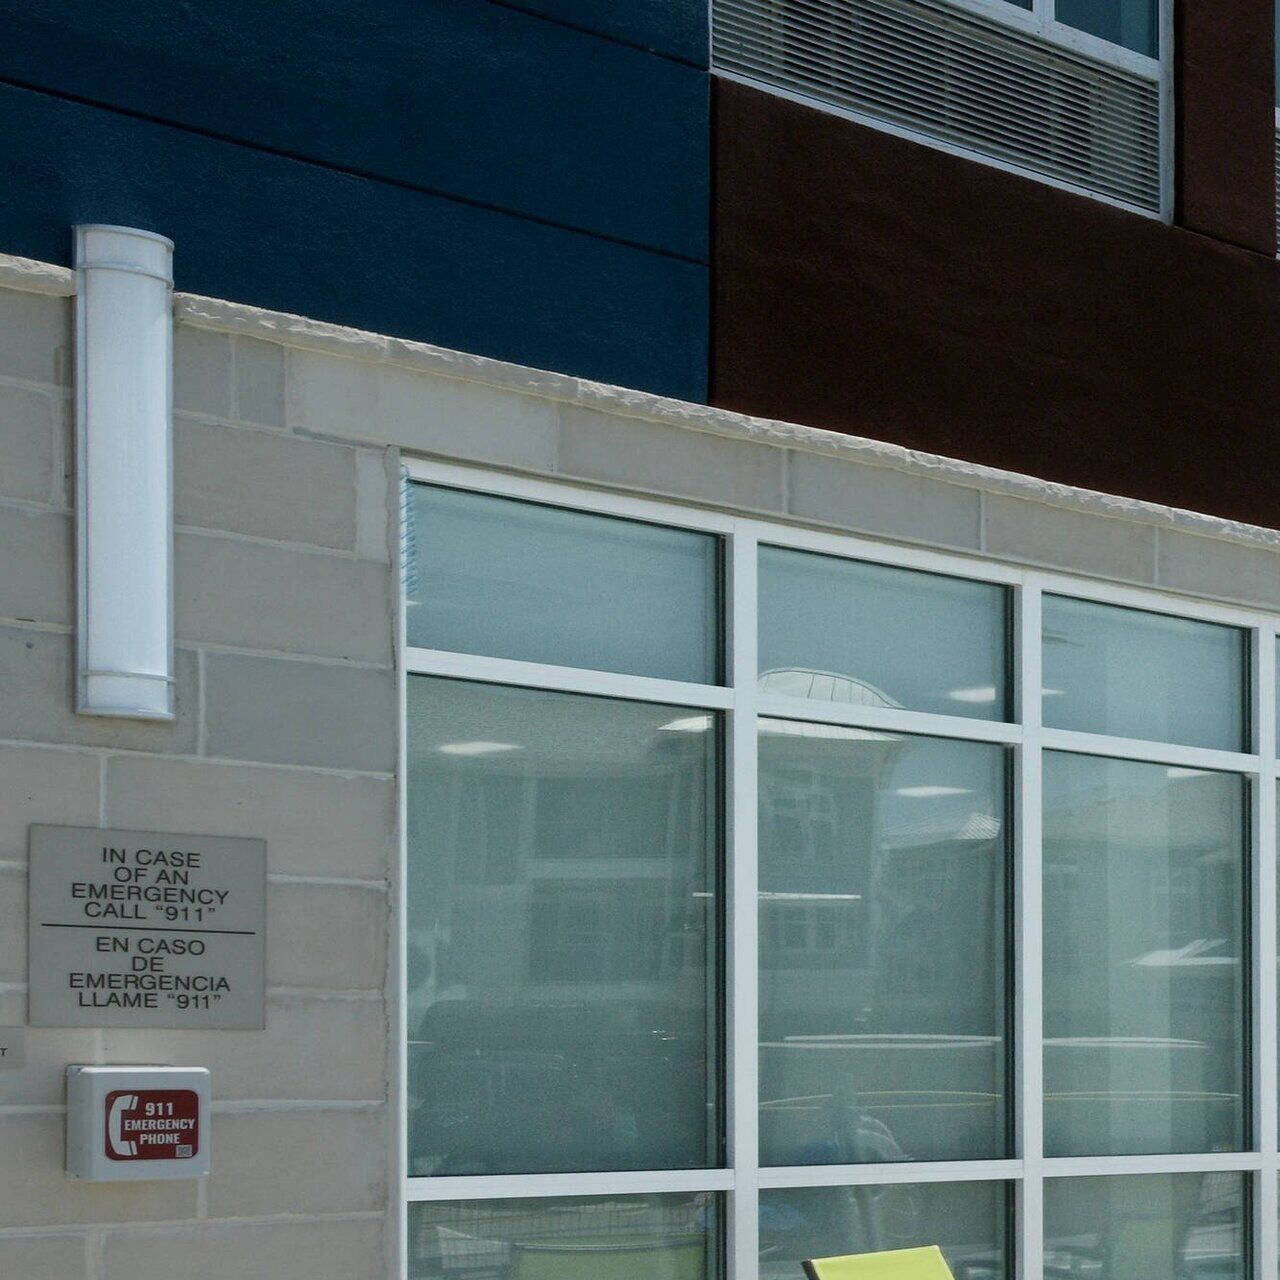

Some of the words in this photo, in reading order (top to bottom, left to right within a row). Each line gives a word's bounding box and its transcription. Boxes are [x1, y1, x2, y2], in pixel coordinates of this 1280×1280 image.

[102, 847, 126, 864] IN
[135, 849, 201, 868] CASE
[114, 866, 148, 883] OF
[155, 869, 189, 885] AN
[72, 882, 229, 905] EMERGENCY
[84, 901, 147, 920] CALL
[96, 936, 129, 953] EN
[138, 937, 205, 956] CASO
[132, 956, 164, 972] DE
[69, 972, 231, 992] EMERGENCIA
[78, 991, 158, 1009] LLAME
[145, 1102, 174, 1116] 911
[124, 1118, 195, 1131] EMERGENCY
[140, 1133, 180, 1145] PHONE
